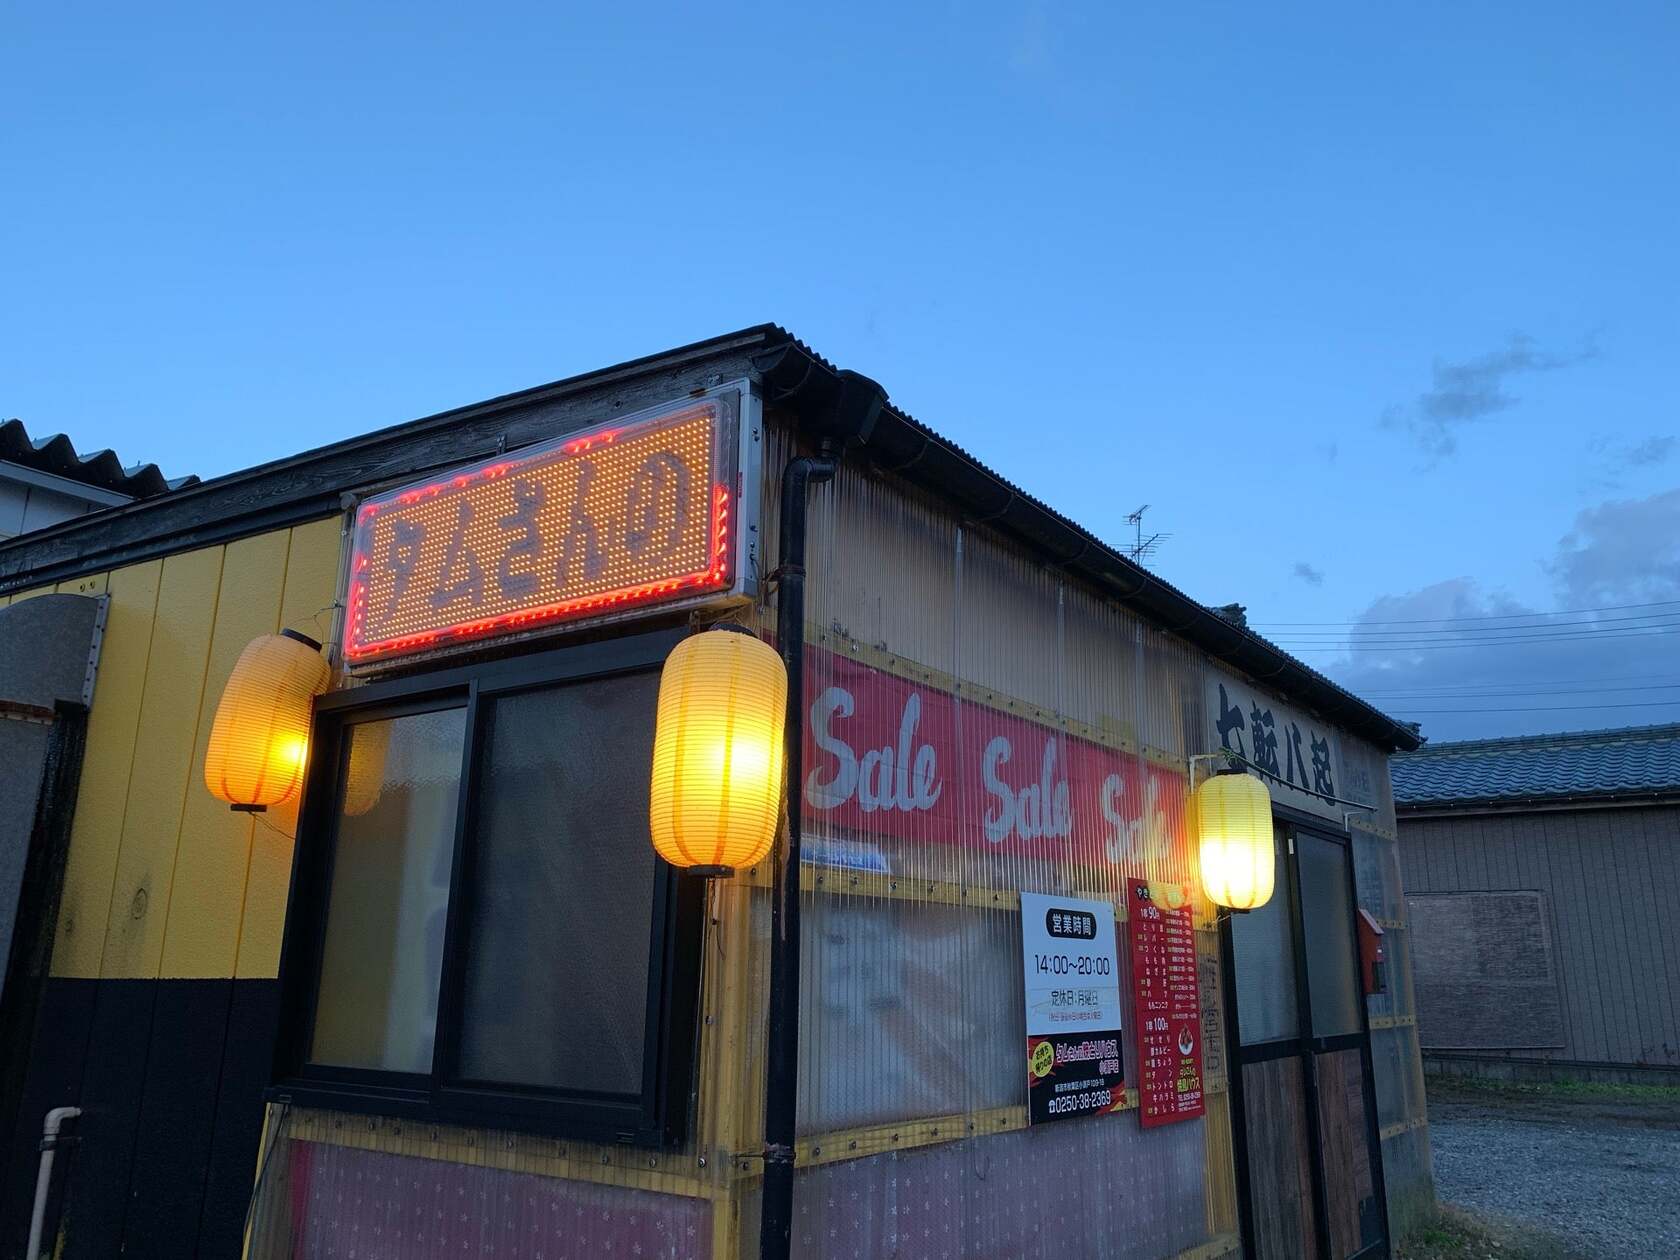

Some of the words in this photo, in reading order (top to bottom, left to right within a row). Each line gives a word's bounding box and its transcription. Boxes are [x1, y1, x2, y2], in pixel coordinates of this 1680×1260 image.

[806, 686, 942, 813] Sale
[982, 735, 1073, 844] Sale
[1052, 913, 1092, 936] 営業時間
